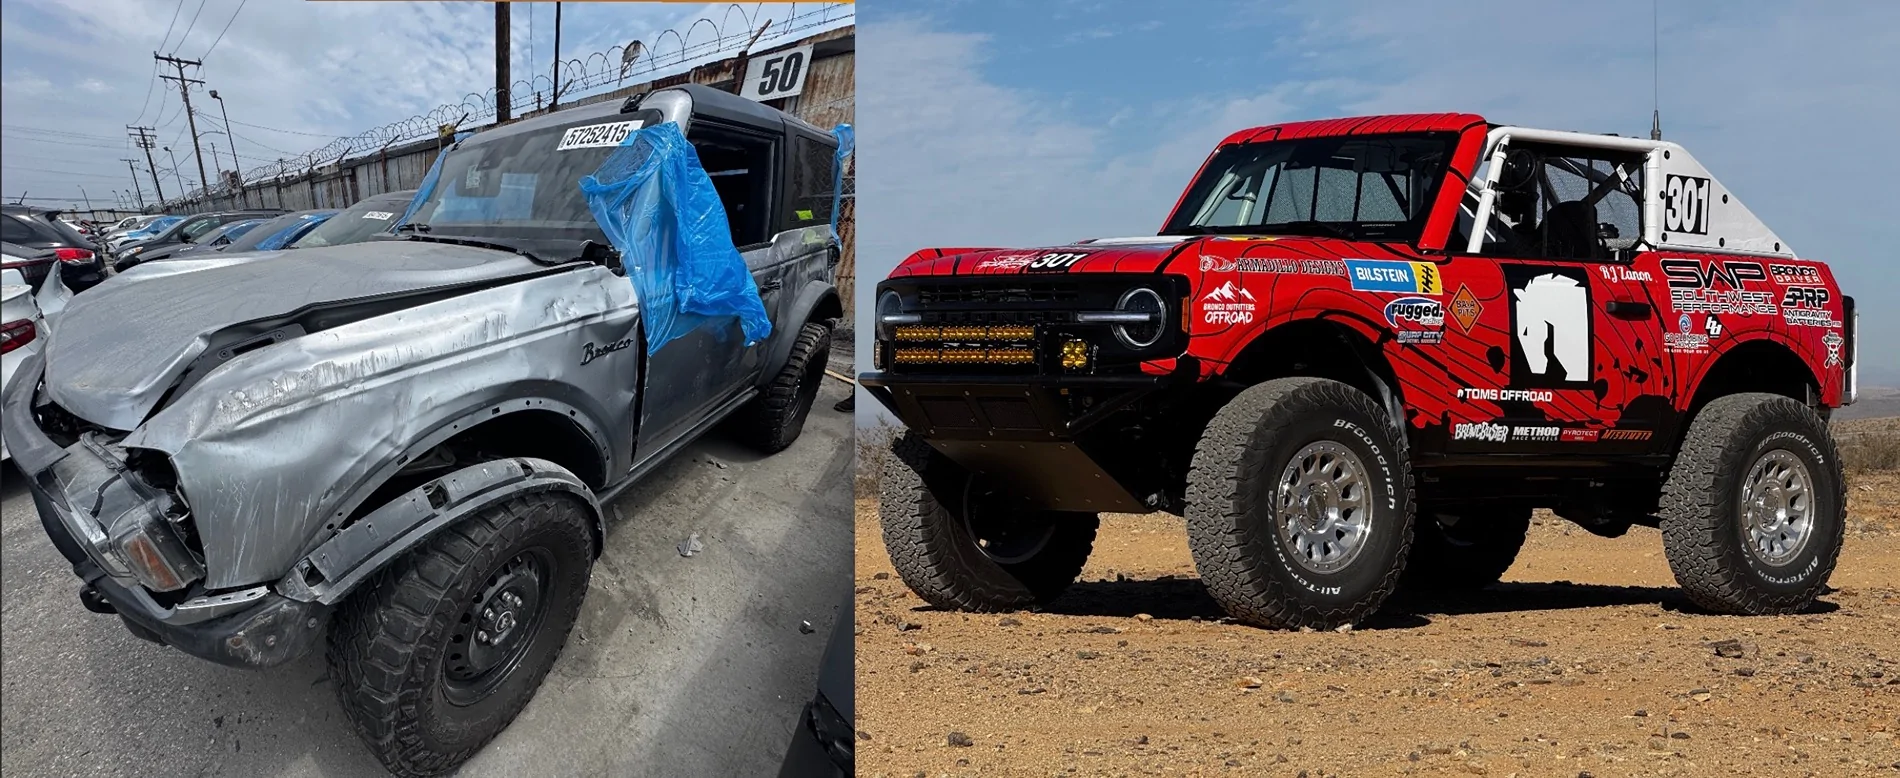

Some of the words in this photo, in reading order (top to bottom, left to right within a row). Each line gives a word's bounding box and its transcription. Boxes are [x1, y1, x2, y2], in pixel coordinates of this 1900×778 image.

[758, 51, 804, 95] 50
[566, 123, 630, 146] 57252415
[1666, 175, 1709, 233] 301
[1030, 253, 1089, 269] 301
[1235, 257, 1300, 274] ARMADILLO
[1300, 259, 1346, 276] DESIGNS
[1355, 267, 1410, 283] BILSTEIN
[1599, 265, 1618, 283] RJ
[1618, 266, 1653, 281] Zanon
[1660, 258, 1768, 291] SWP
[1769, 264, 1818, 276] BRONCO
[1775, 274, 1821, 283] DRIVER
[1670, 289, 1774, 304] SOUTHWEST
[1781, 286, 1830, 309] PRP
[1203, 303, 1225, 311] BRONCO
[1226, 303, 1256, 311] OUTFITTERS
[1458, 309, 1475, 317] PITS
[1672, 301, 1778, 315] PERFORMANCE
[1783, 308, 1832, 319] ANTIGRAVITY
[1204, 311, 1254, 325] OFFROAD
[1786, 318, 1832, 327] BATTERIES
[1397, 330, 1422, 343] SURF
[1423, 330, 1444, 343] CITY
[580, 338, 633, 366] Bronco
[1464, 388, 1498, 400] TOMS
[1500, 389, 1553, 402] OFFROAD
[1513, 426, 1560, 437] METHOD
[1563, 429, 1598, 437] PYROTECT
[1757, 431, 1824, 465] BFGoodrich
[1333, 418, 1396, 510] BFGoodrich
[1757, 555, 1819, 585] All-Terrain
